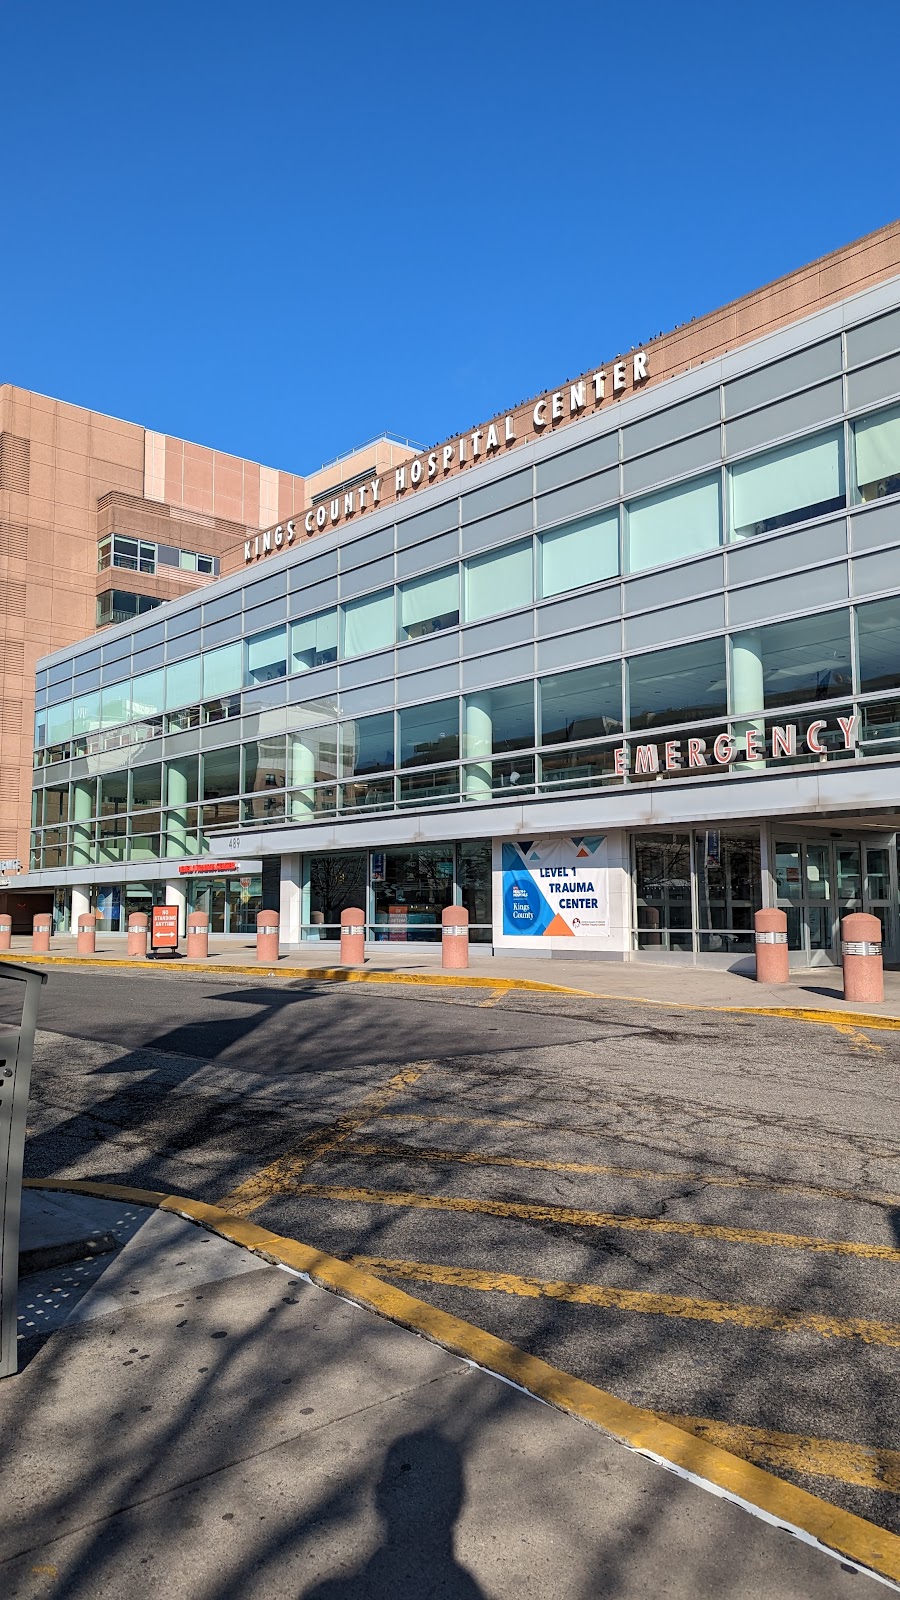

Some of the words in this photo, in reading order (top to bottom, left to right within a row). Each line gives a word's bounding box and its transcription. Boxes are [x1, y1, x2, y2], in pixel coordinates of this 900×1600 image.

[244, 520, 296, 562] KINGS
[304, 478, 383, 532] COUNTY
[395, 416, 517, 492] HOSPITAL
[533, 351, 651, 427] CENTER
[614, 715, 861, 776] EMERGENCY
[228, 837, 241, 850] 489
[540, 867, 569, 878] LEVEL
[571, 867, 576, 877] 1
[549, 882, 595, 893] TRAUMA
[513, 902, 530, 912] Kings
[559, 898, 598, 909] CENTER
[513, 911, 534, 920] County
